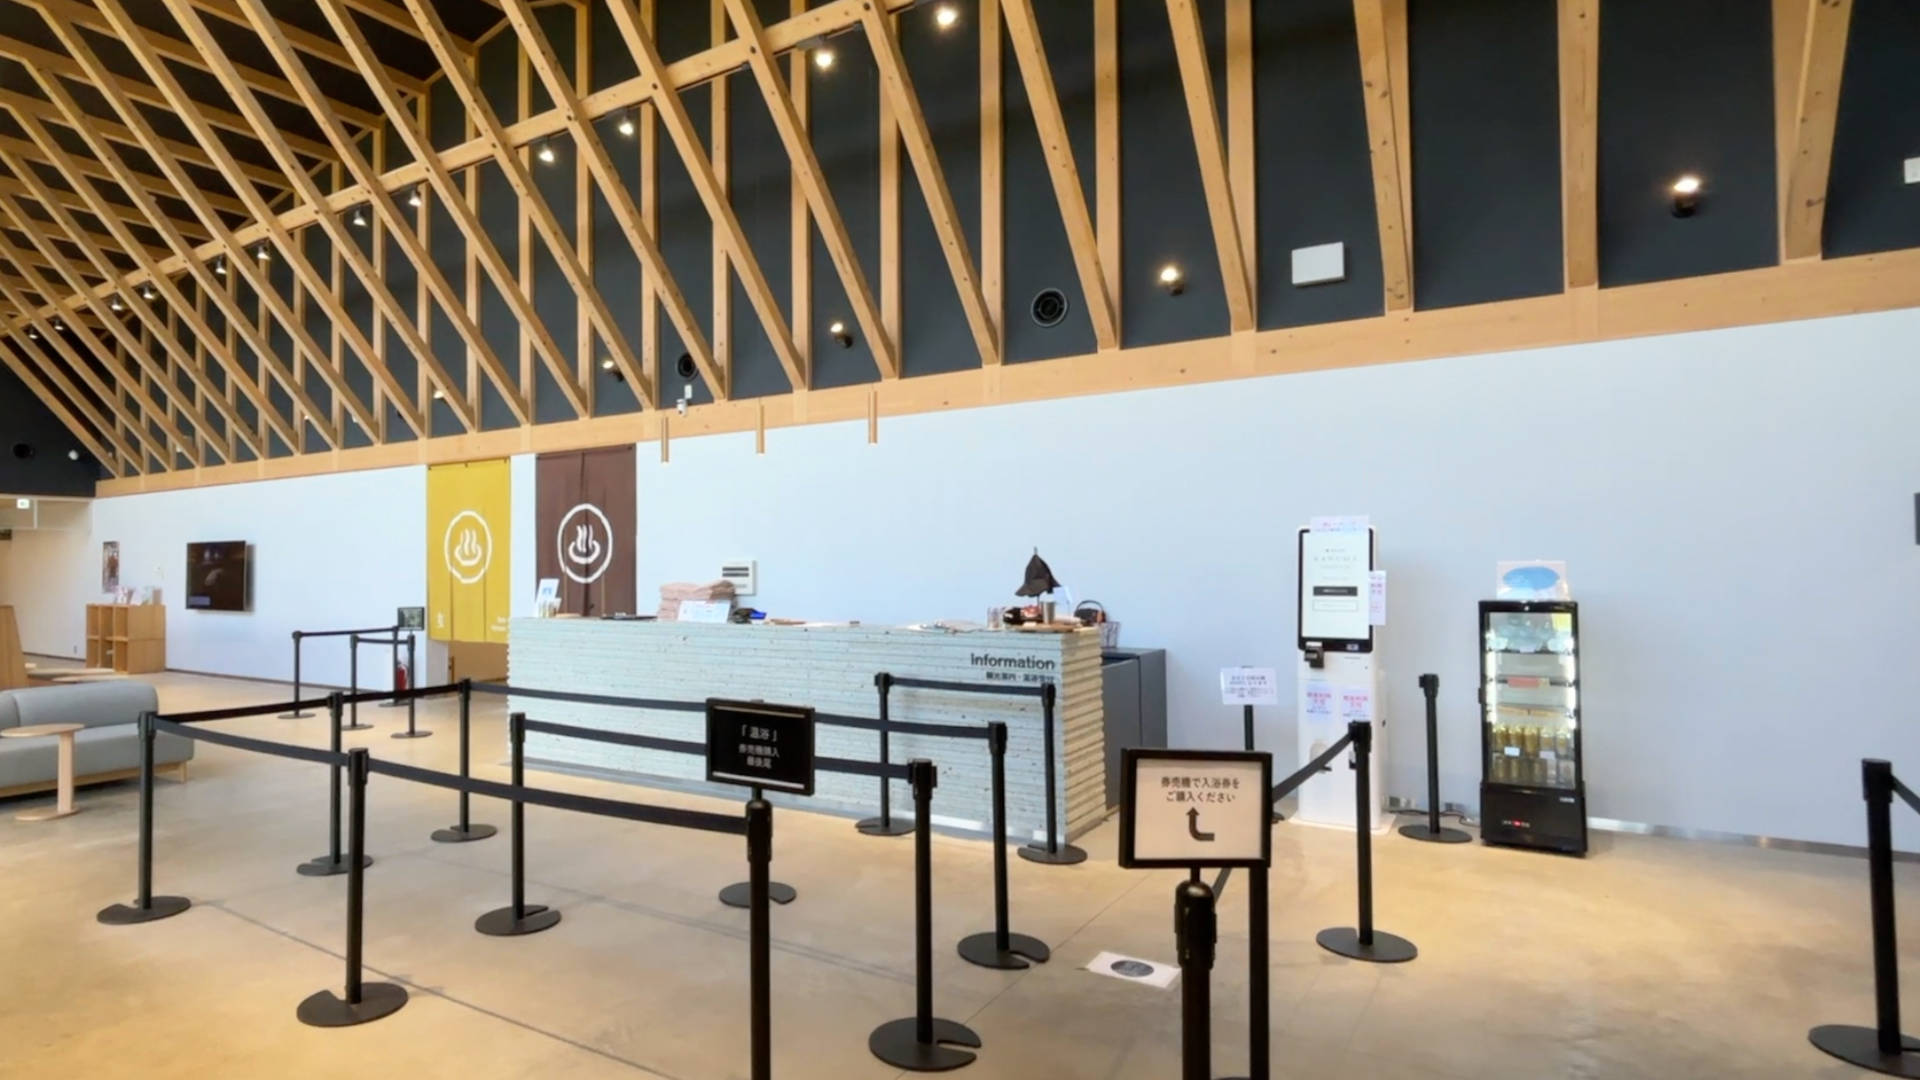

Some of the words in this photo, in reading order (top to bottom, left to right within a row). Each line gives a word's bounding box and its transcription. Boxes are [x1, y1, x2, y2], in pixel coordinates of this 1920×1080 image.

[1161, 776, 1240, 790] 券売機で入浴券を
[1166, 790, 1235, 802] ご購入ください
